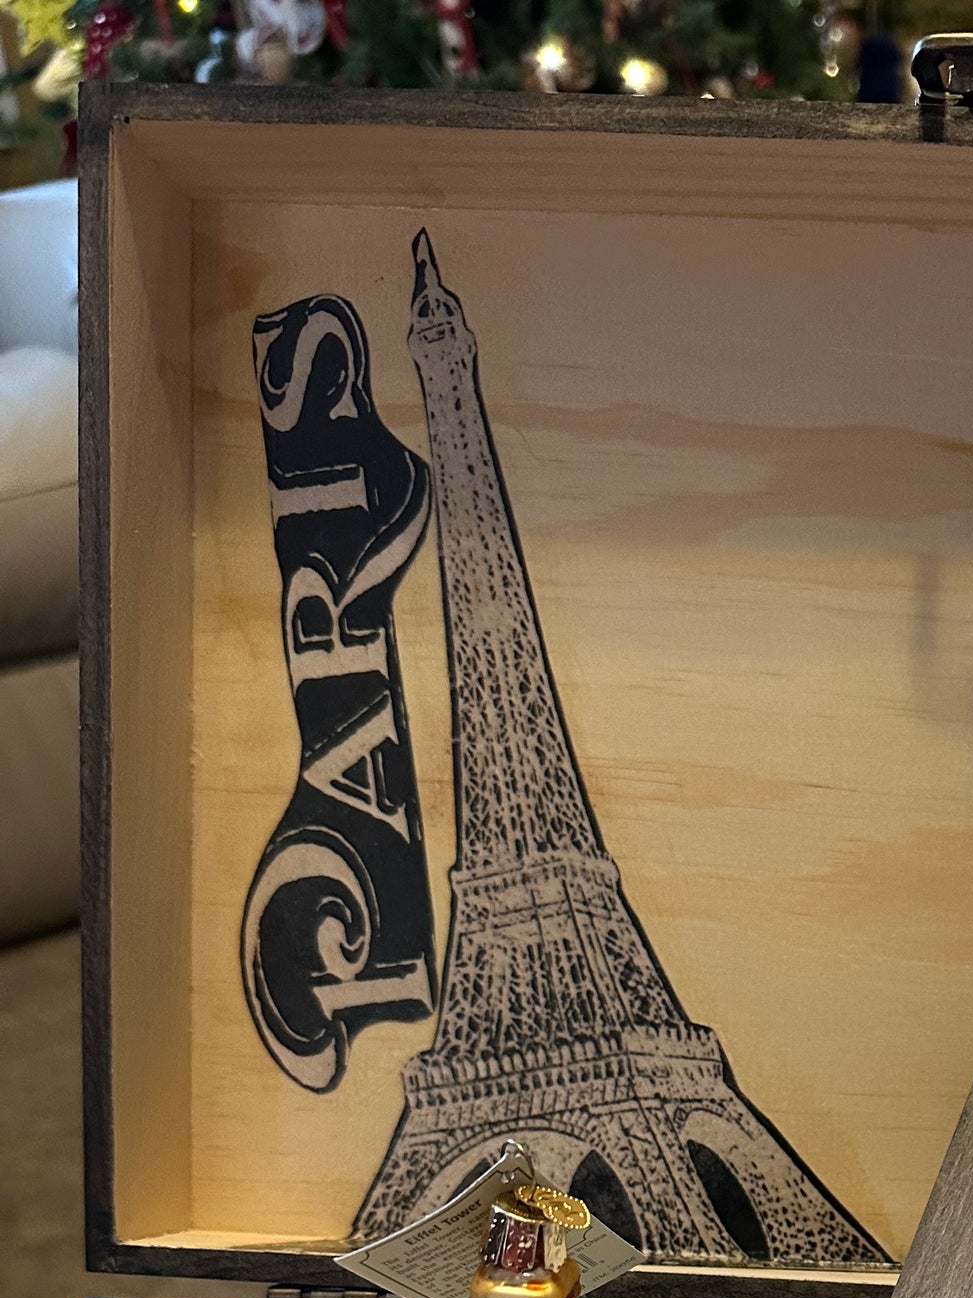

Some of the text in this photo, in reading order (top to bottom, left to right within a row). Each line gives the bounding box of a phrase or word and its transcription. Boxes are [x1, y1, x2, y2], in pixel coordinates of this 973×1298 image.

[241, 296, 434, 1092] PARIS
[405, 1199, 483, 1245] Eiffel Tower
